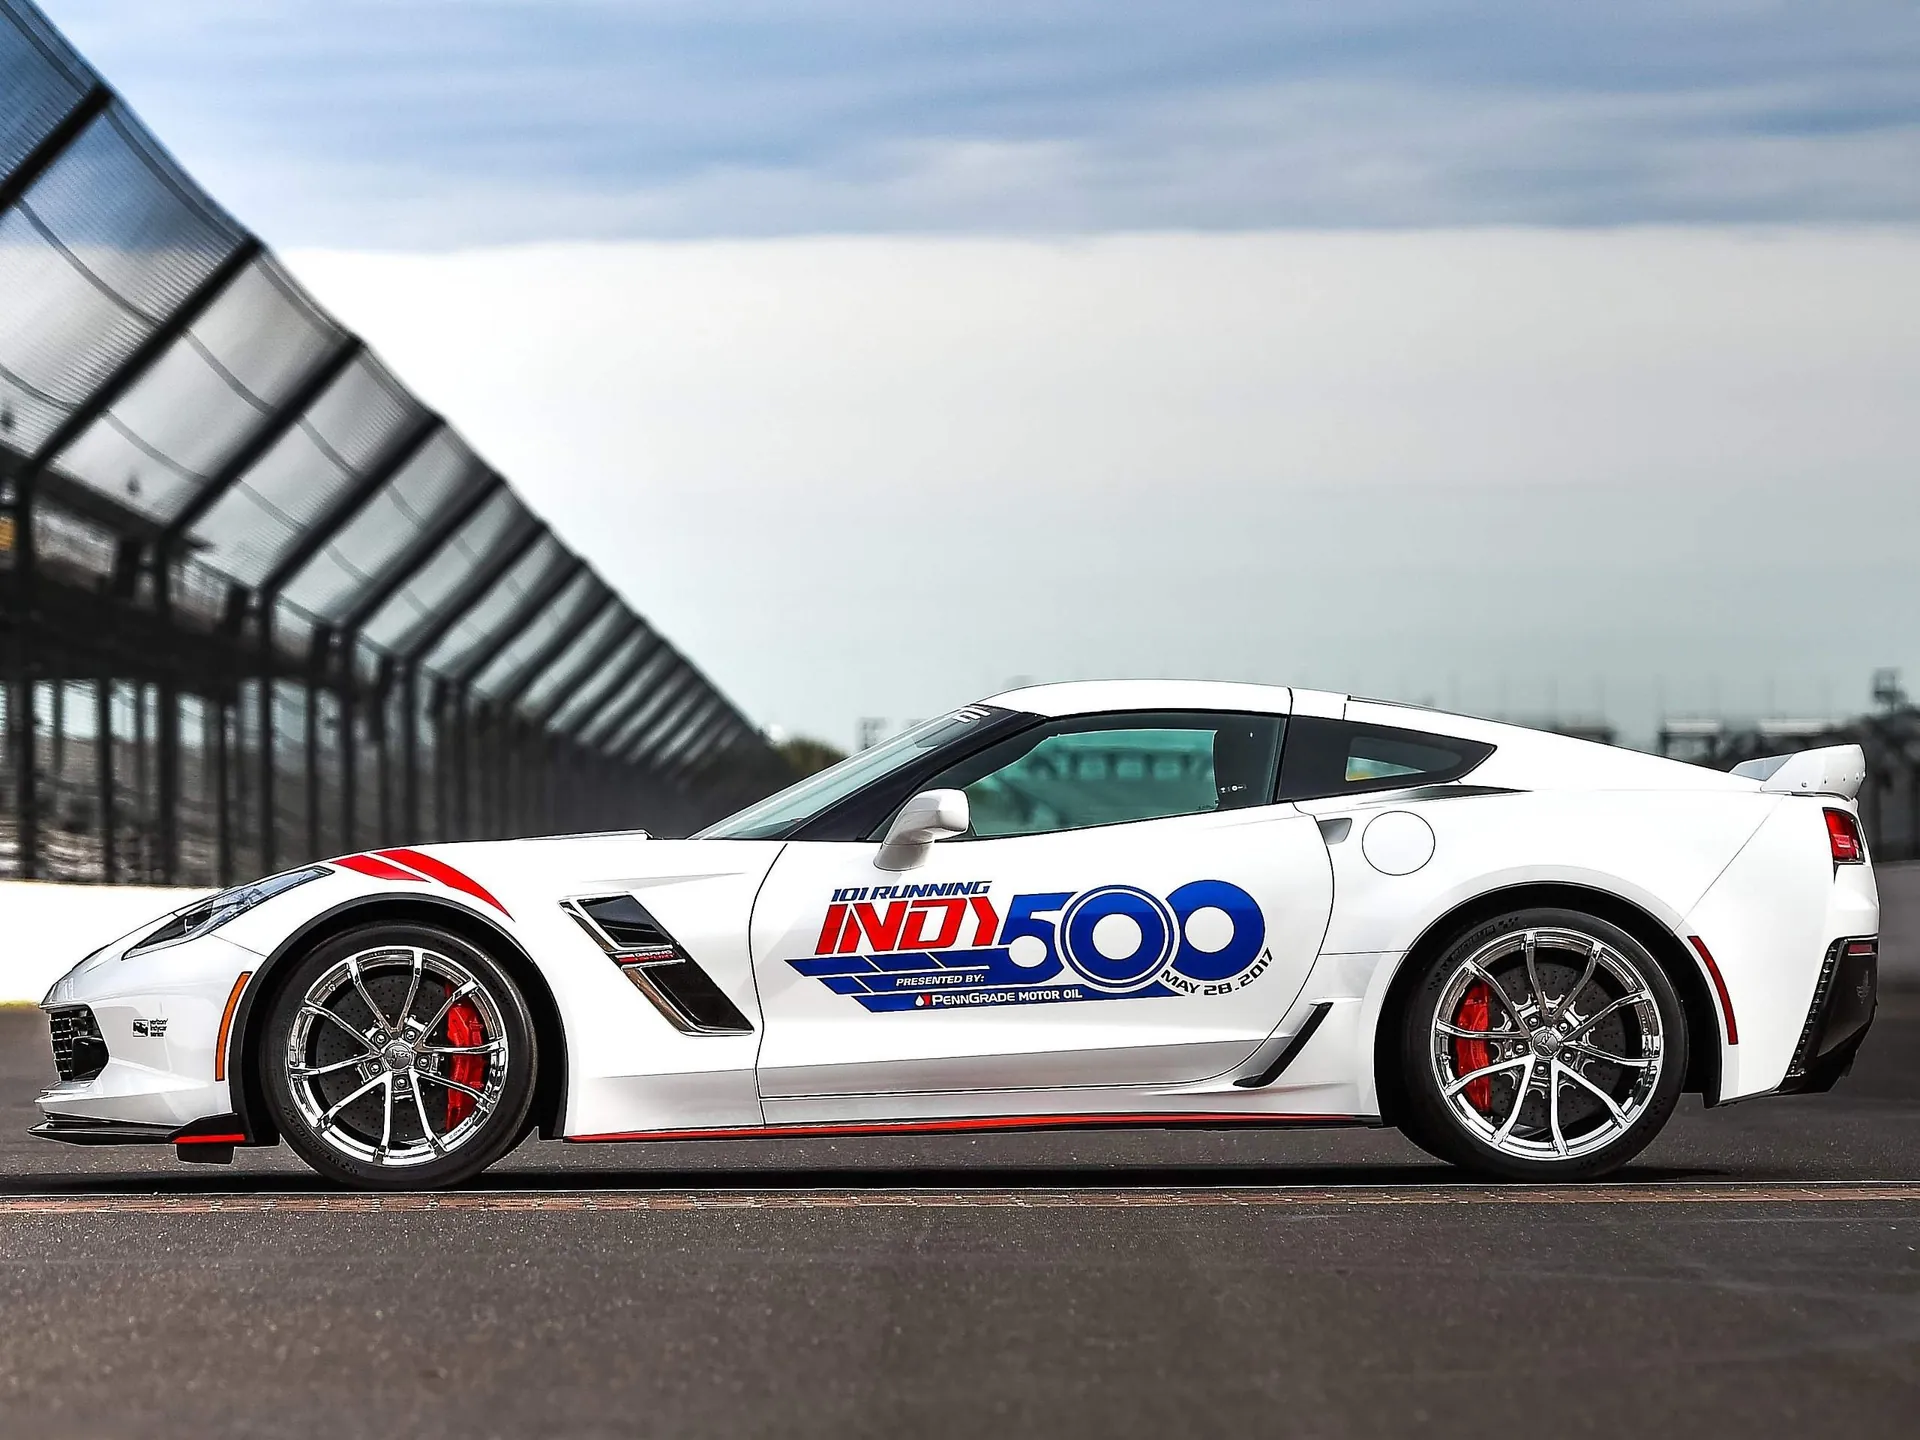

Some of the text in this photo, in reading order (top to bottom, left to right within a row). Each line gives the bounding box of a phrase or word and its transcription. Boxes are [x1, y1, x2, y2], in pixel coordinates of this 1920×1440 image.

[831, 880, 993, 902] 101 RUNNING
[814, 879, 1266, 988] INDY 500
[895, 973, 985, 987] PRESENTED BY:
[1160, 969, 1201, 994] MAY
[1018, 990, 1060, 1001] MOTOR
[1063, 988, 1083, 999] OIL
